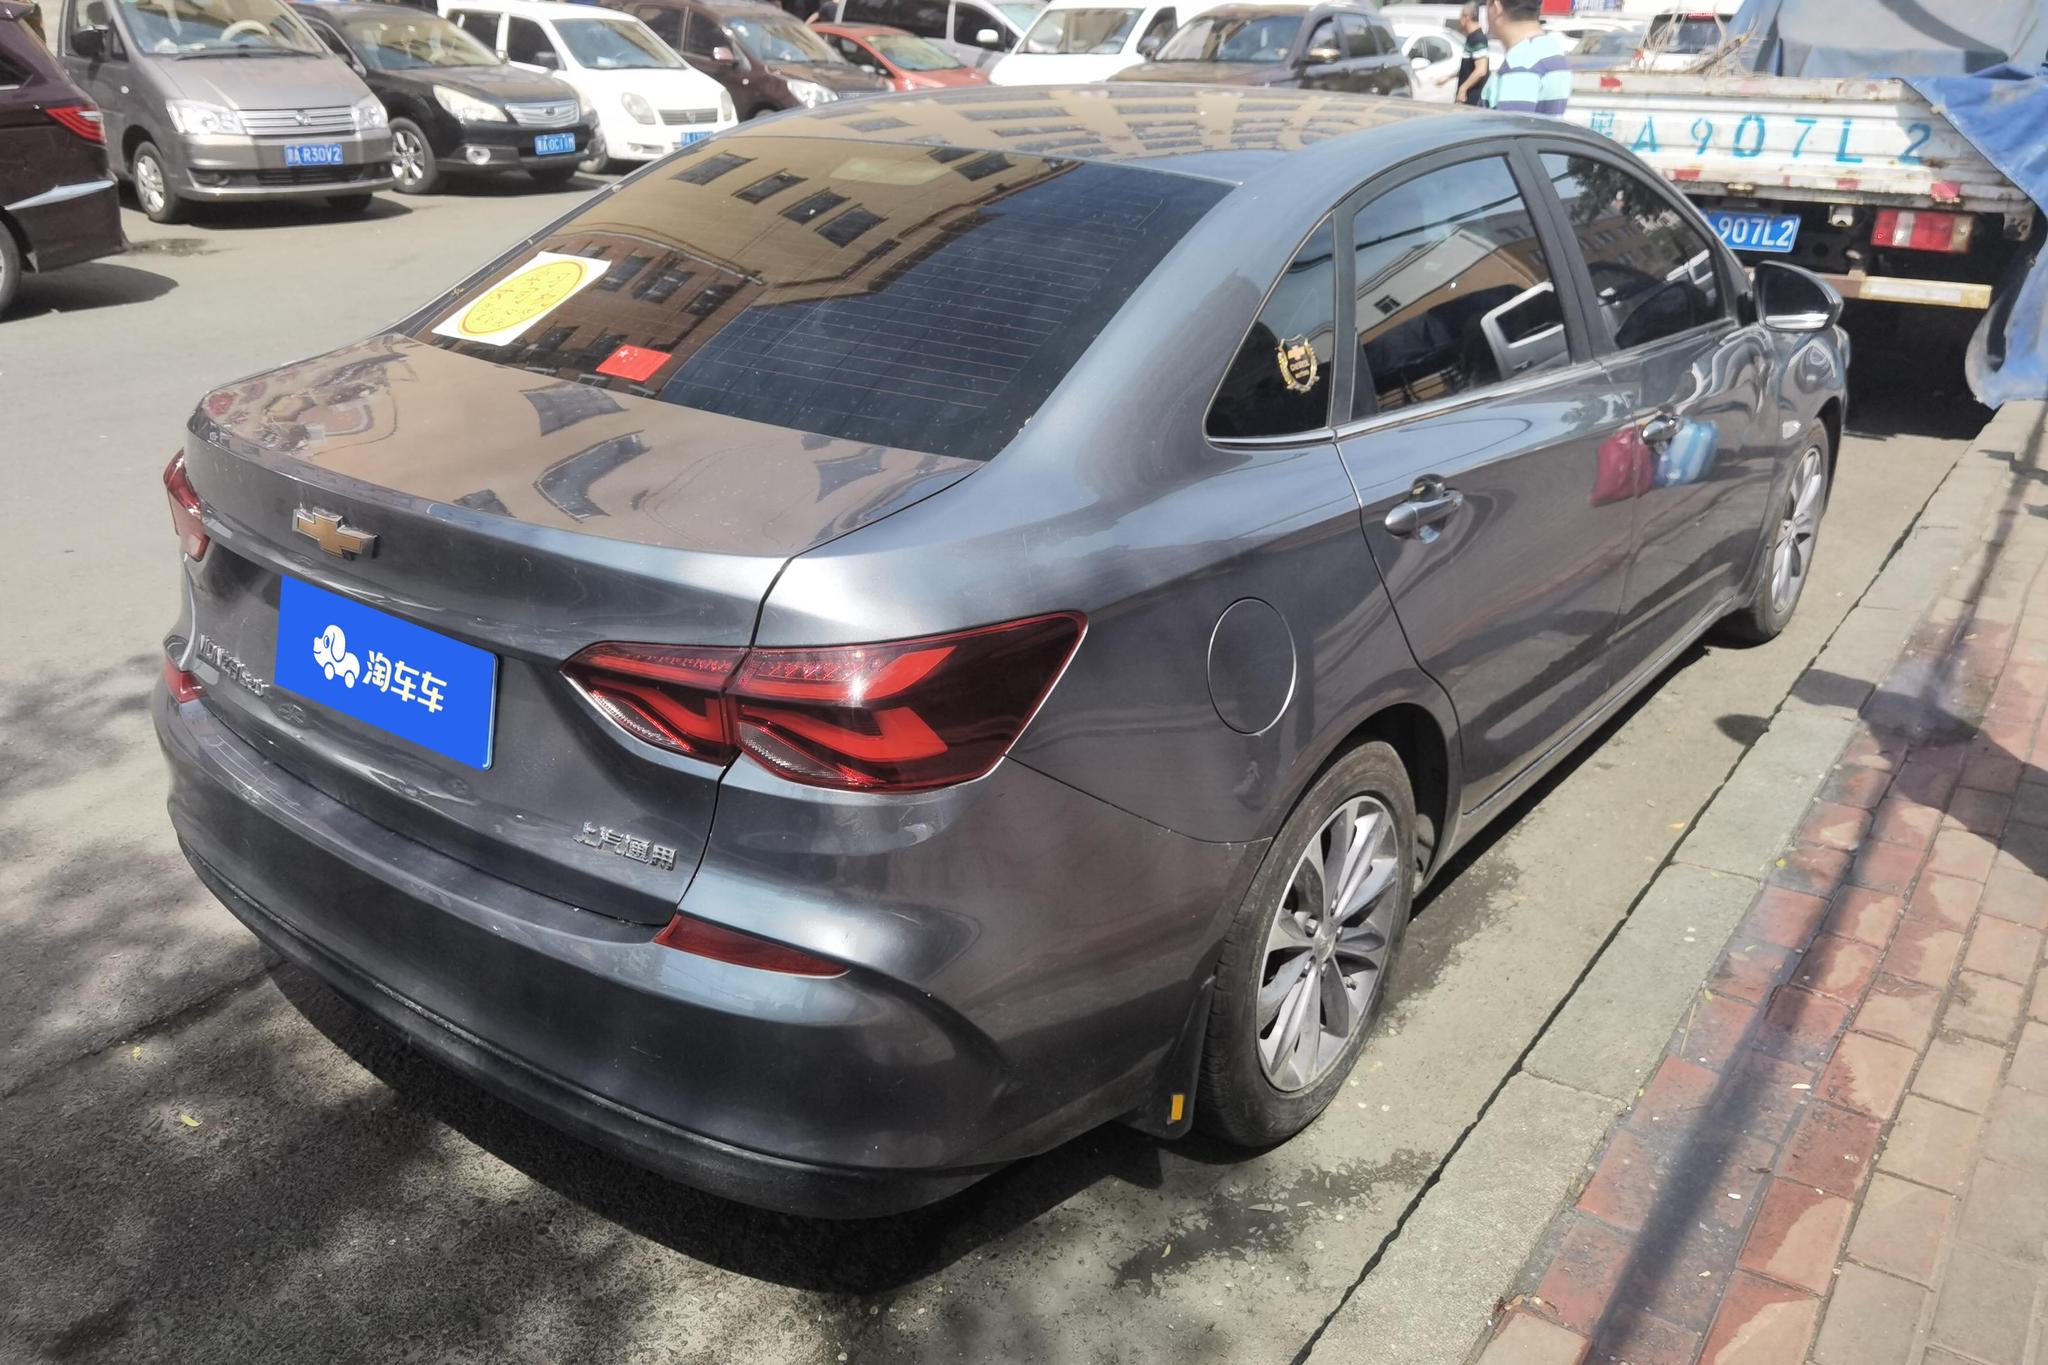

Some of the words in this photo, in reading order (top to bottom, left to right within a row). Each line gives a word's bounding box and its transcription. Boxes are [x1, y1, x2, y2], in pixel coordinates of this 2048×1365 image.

[1704, 212, 1795, 247] 907L2
[572, 821, 678, 871] 上汽通用
